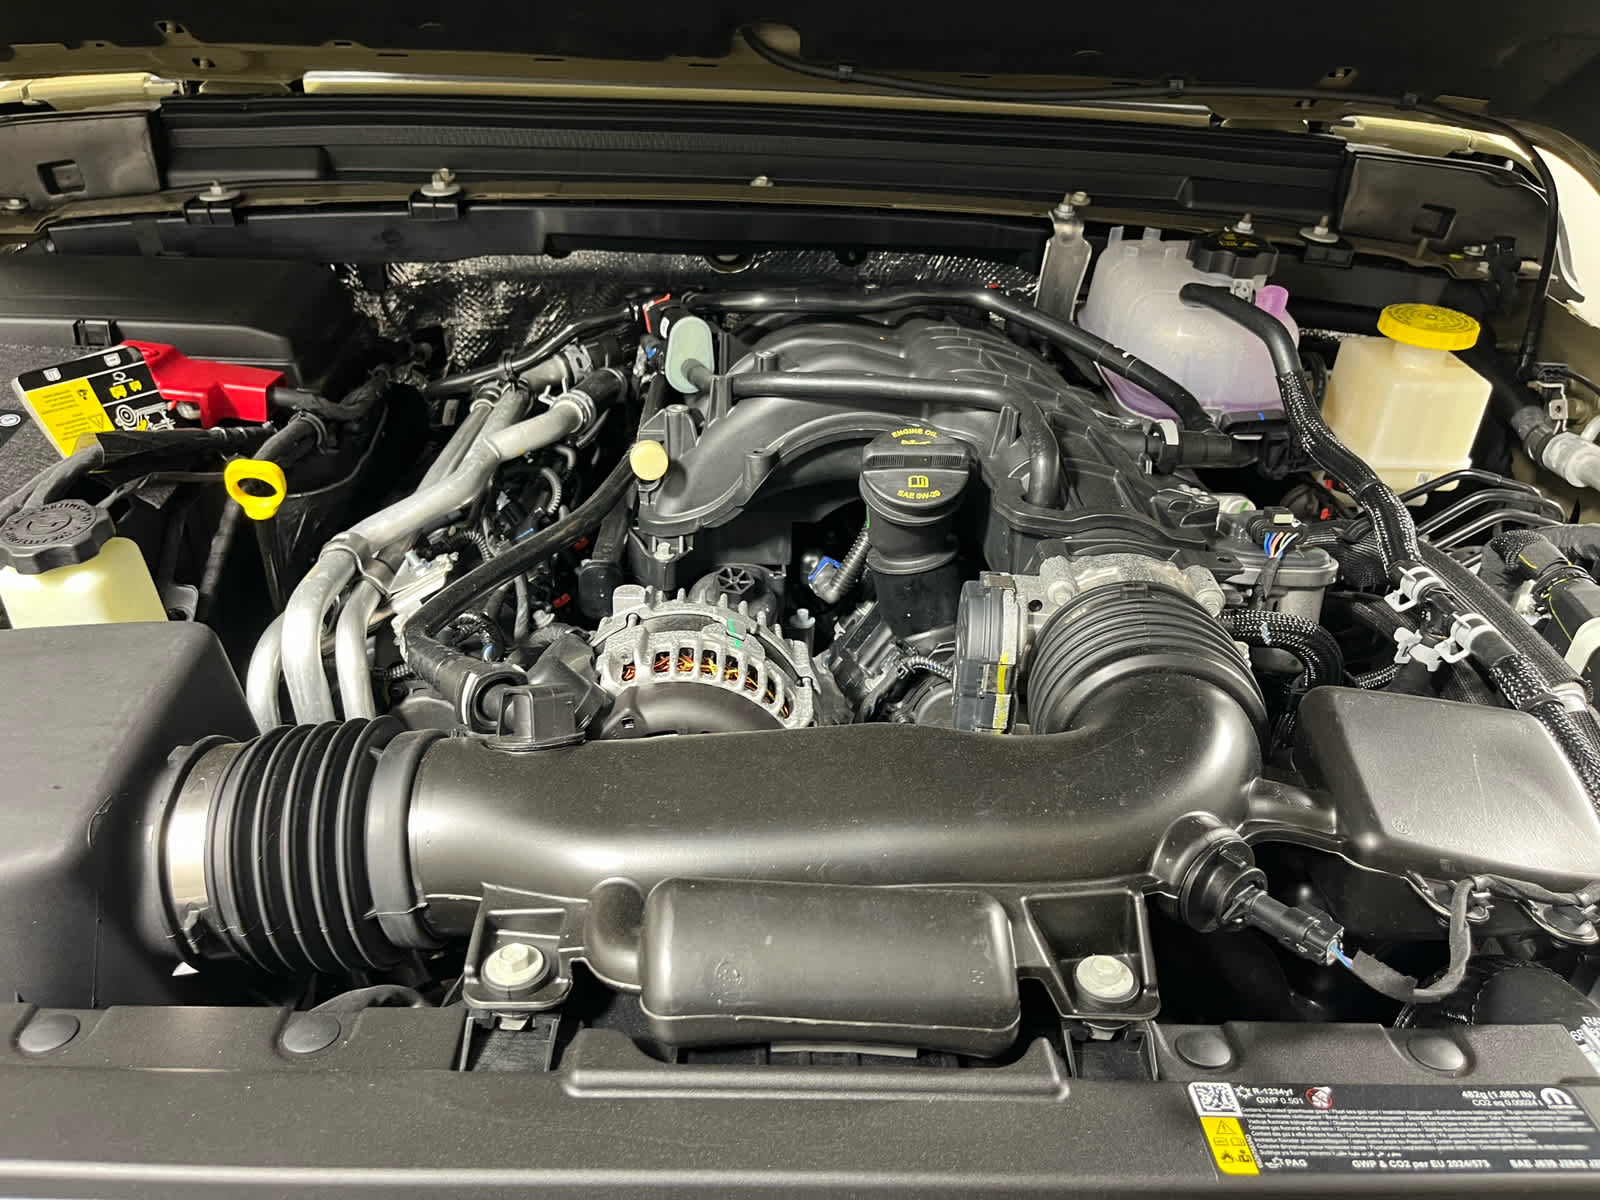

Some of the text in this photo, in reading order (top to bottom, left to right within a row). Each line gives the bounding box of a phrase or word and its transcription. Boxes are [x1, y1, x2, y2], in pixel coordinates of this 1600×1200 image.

[891, 428, 938, 438] ENGINE OIL
[897, 490, 941, 499] SAE 0W-20
[1252, 1087, 1293, 1096] R-1234yf
[1284, 1159, 1308, 1167] PAG
[1351, 1160, 1376, 1168] GWP
[1379, 1160, 1388, 1168] &
[1388, 1160, 1411, 1168] CO2
[1412, 1161, 1429, 1170] per
[1429, 1160, 1445, 1168] EU
